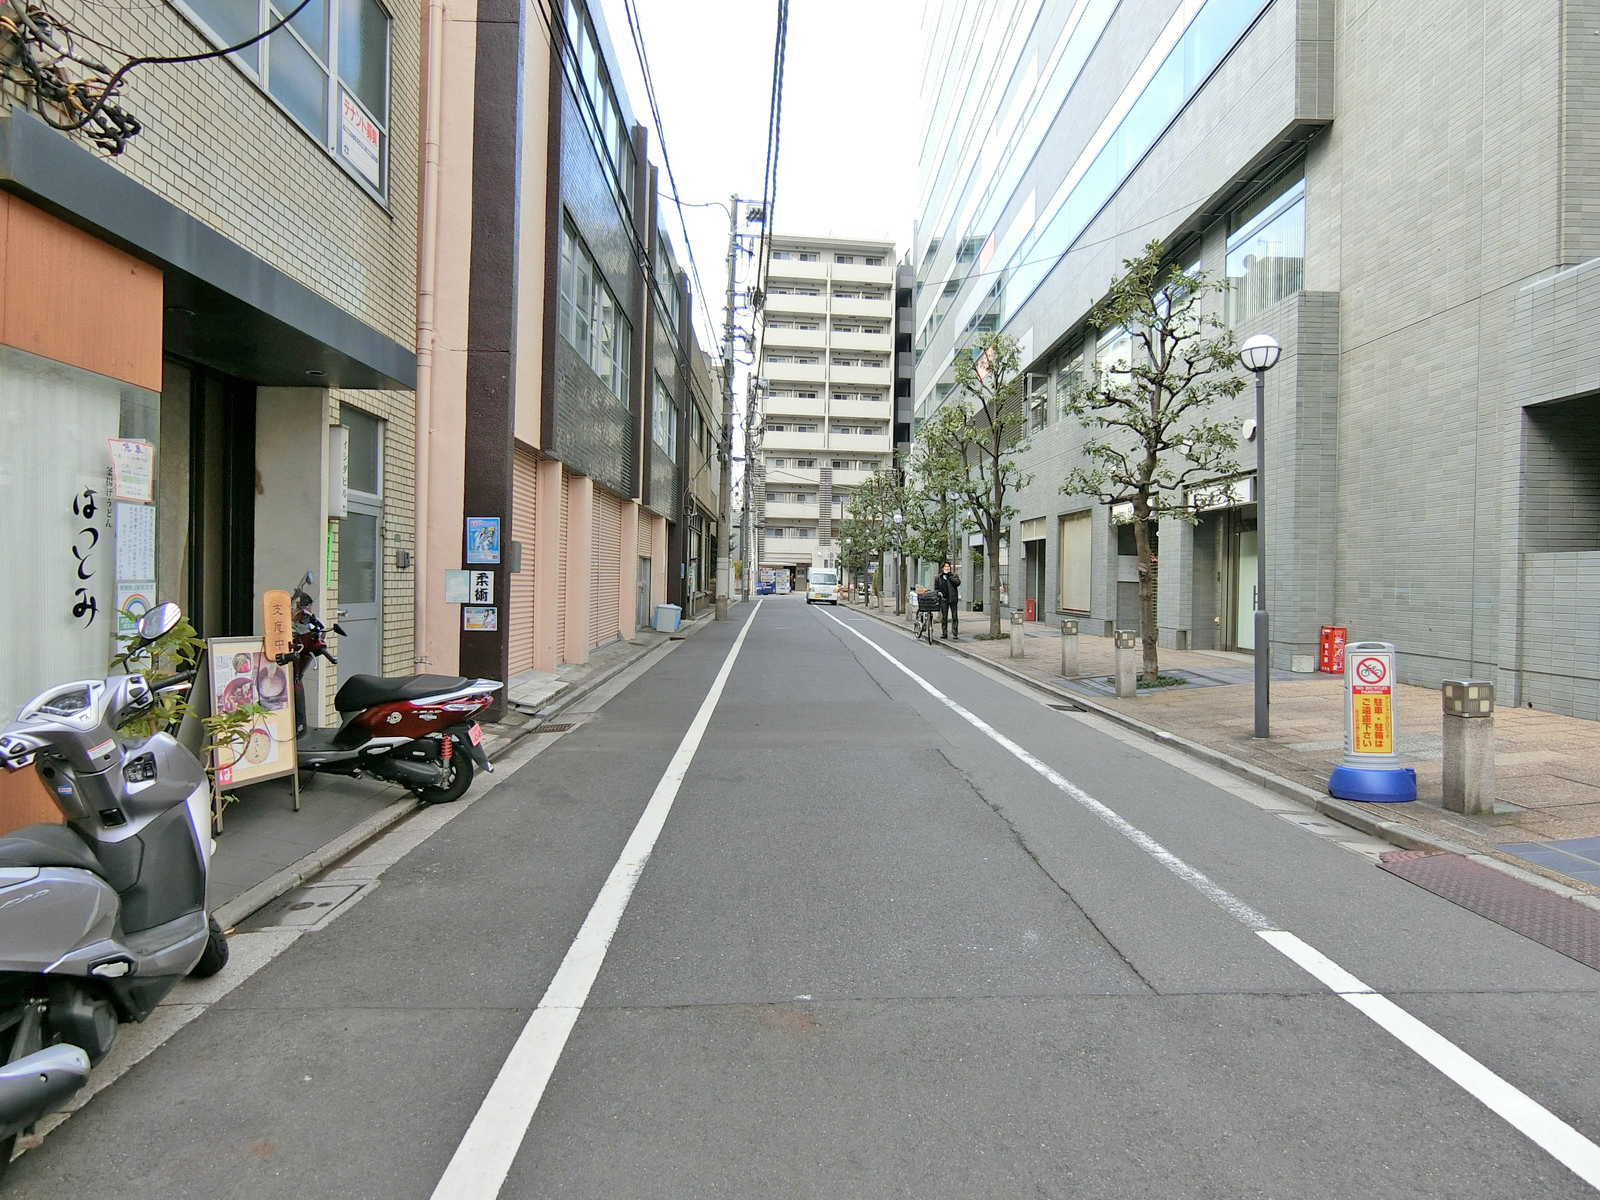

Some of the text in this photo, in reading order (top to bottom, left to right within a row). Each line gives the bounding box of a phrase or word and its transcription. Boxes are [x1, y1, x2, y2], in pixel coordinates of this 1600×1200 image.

[344, 98, 378, 148] テナント募集
[72, 484, 100, 630] はつとみ
[474, 572, 489, 602] 柔術
[272, 604, 285, 651] 支度中
[1362, 698, 1372, 748] ご遠慮下さい
[1373, 698, 1384, 748] 駐車・駐輪は
